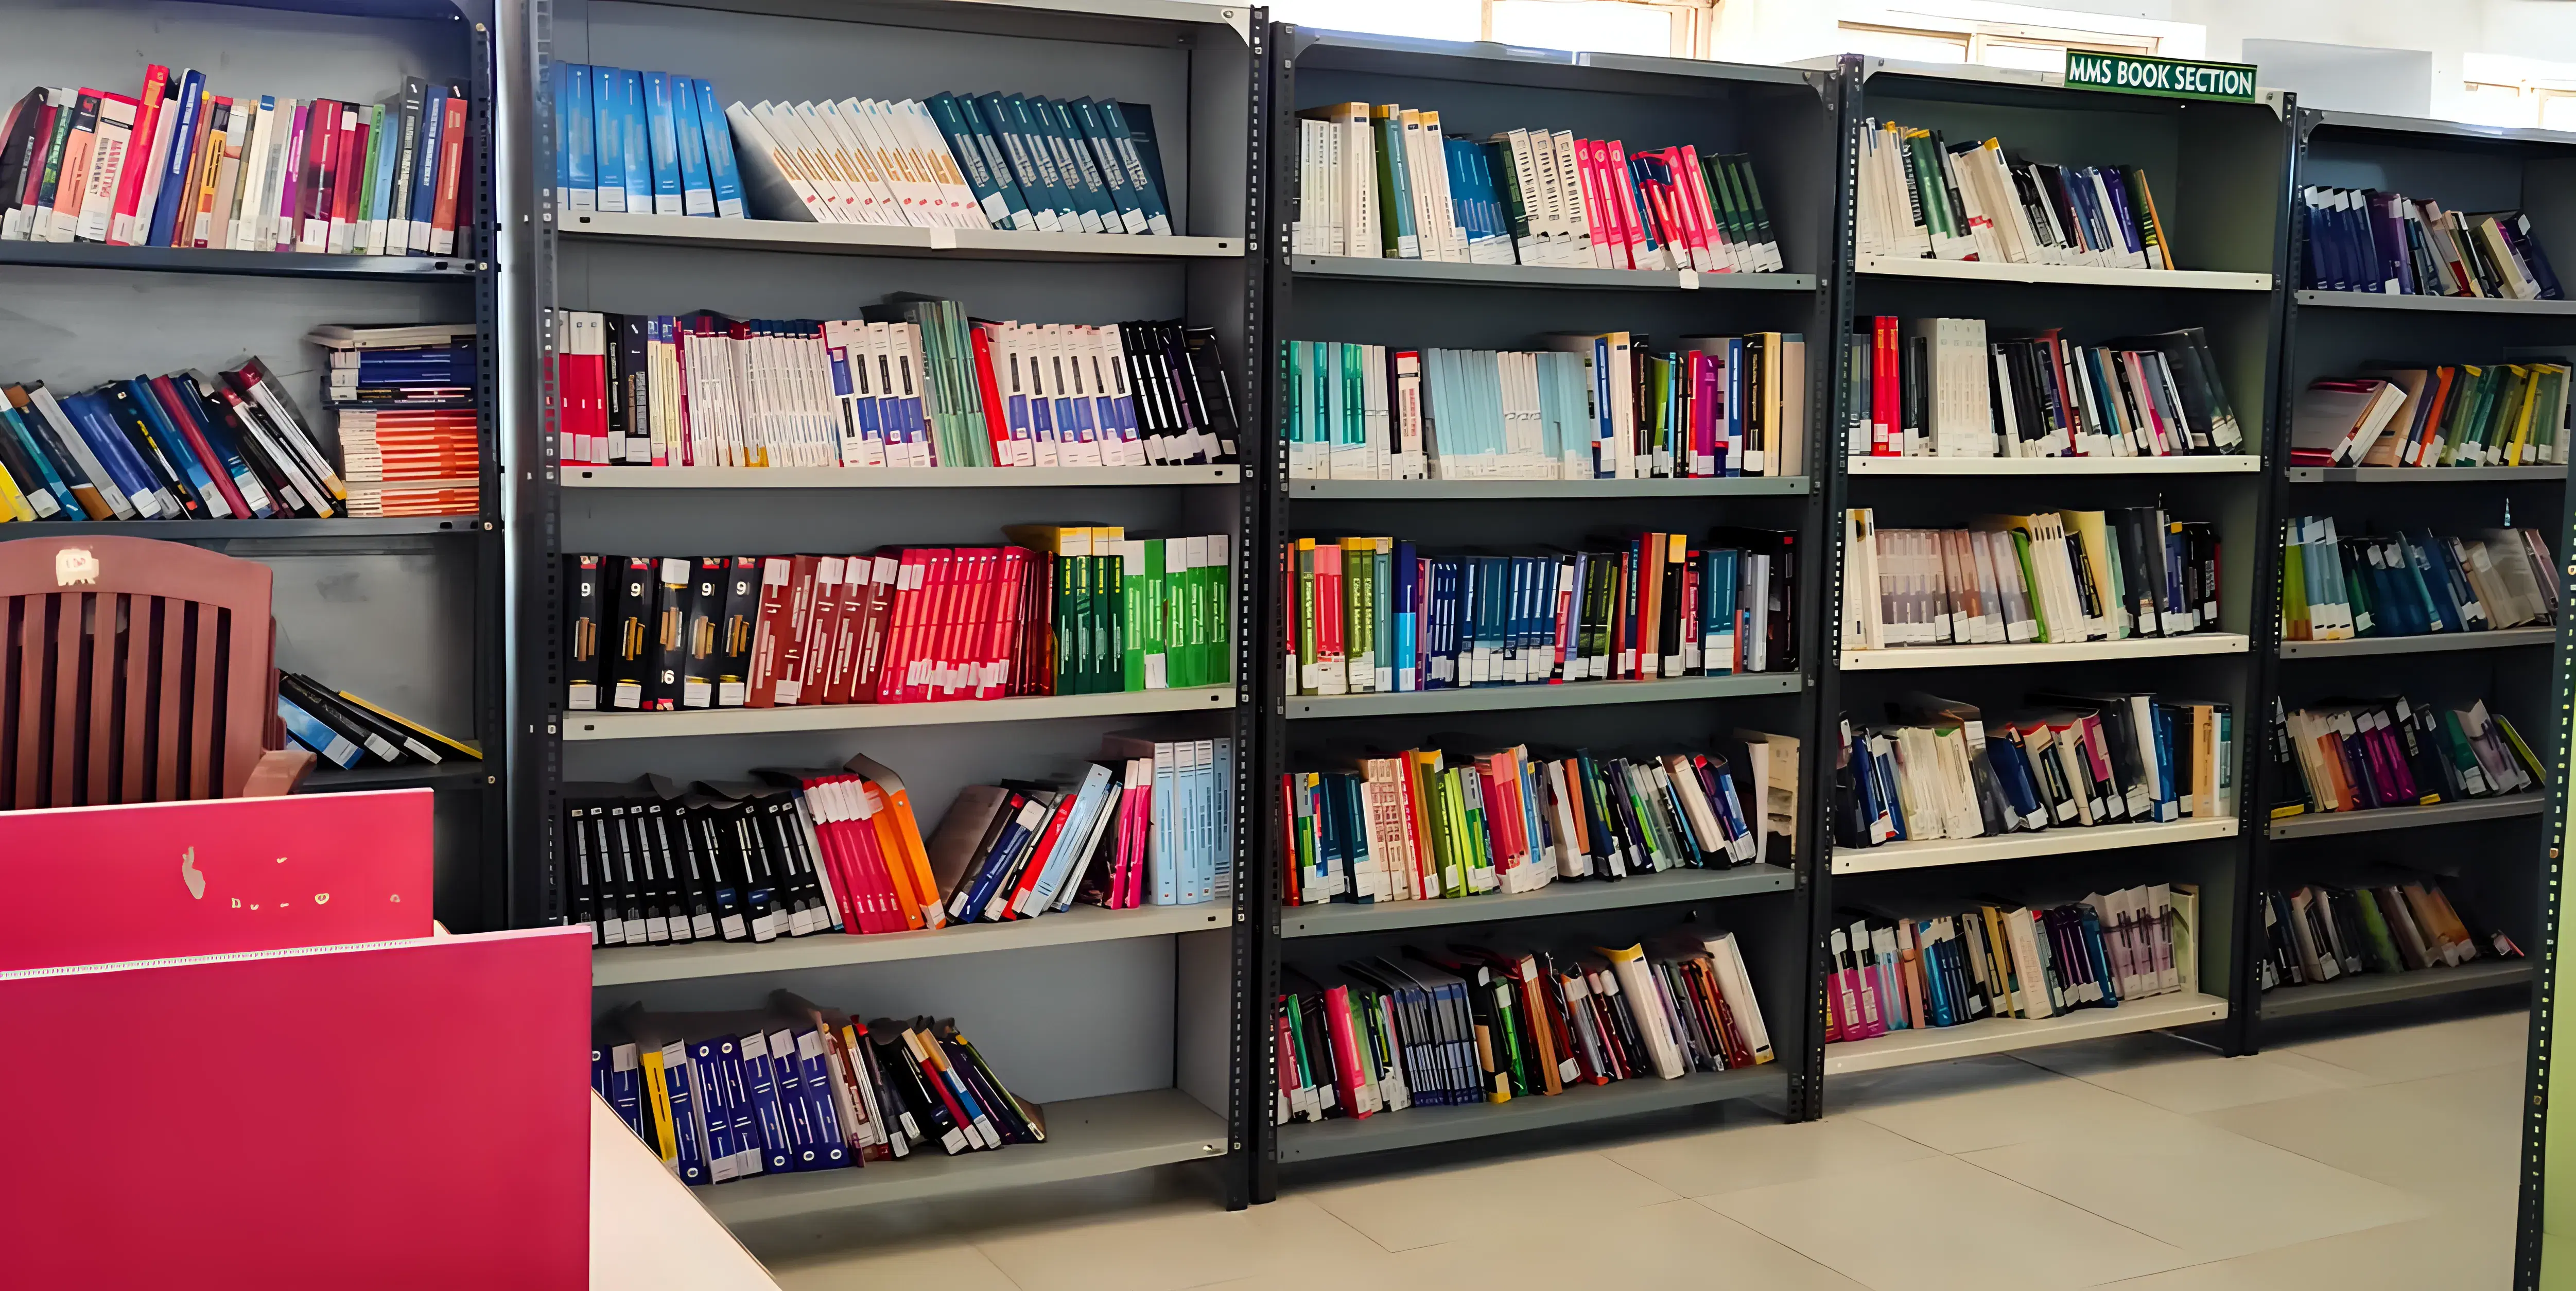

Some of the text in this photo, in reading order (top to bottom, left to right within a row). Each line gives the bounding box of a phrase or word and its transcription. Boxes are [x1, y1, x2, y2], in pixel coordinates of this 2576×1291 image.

[2069, 56, 2252, 95] MMS BOOK SECTION
